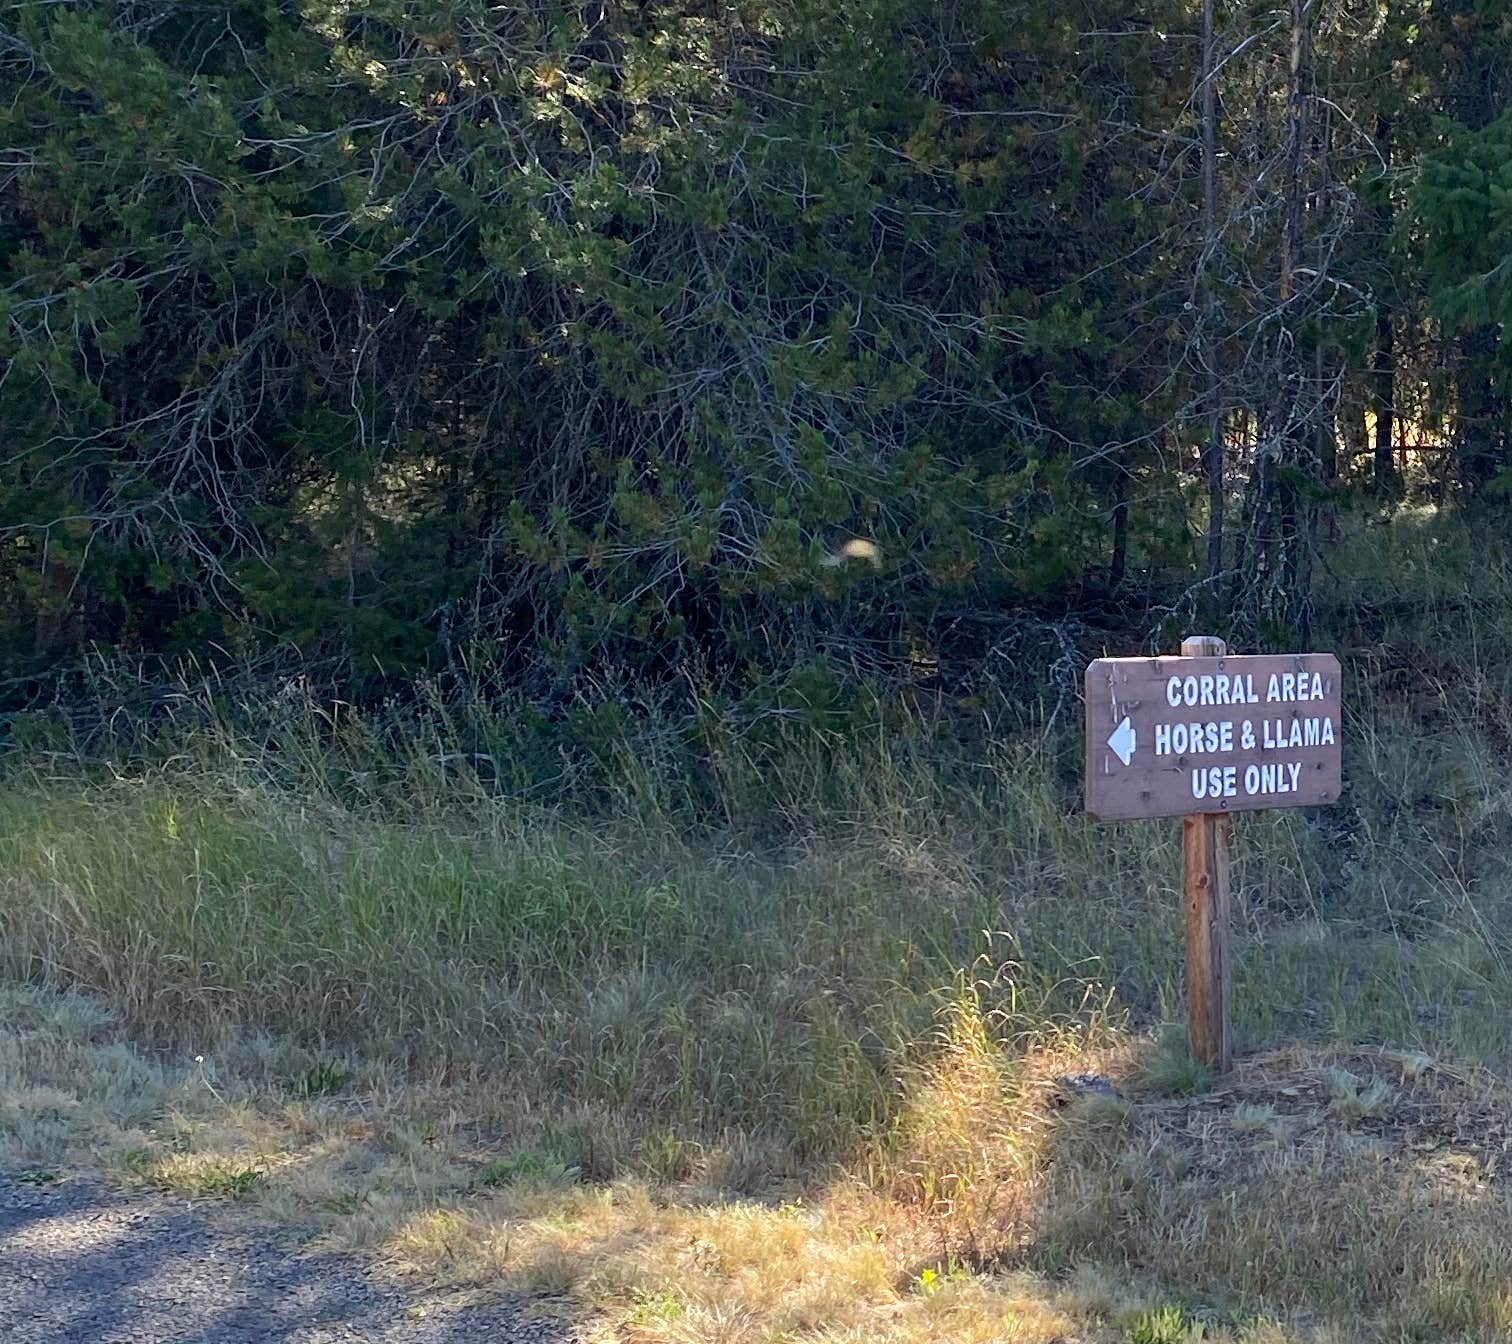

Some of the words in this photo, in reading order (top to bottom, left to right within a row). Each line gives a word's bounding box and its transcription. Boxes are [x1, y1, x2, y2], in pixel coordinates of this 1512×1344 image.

[1166, 674, 1259, 707] CORRAL
[1266, 672, 1324, 702] AREA
[1155, 721, 1233, 755] HORSE
[1241, 719, 1256, 749] &
[1263, 717, 1335, 749] LLAMA
[1191, 766, 1237, 799] USE
[1244, 762, 1302, 795] ONLY
